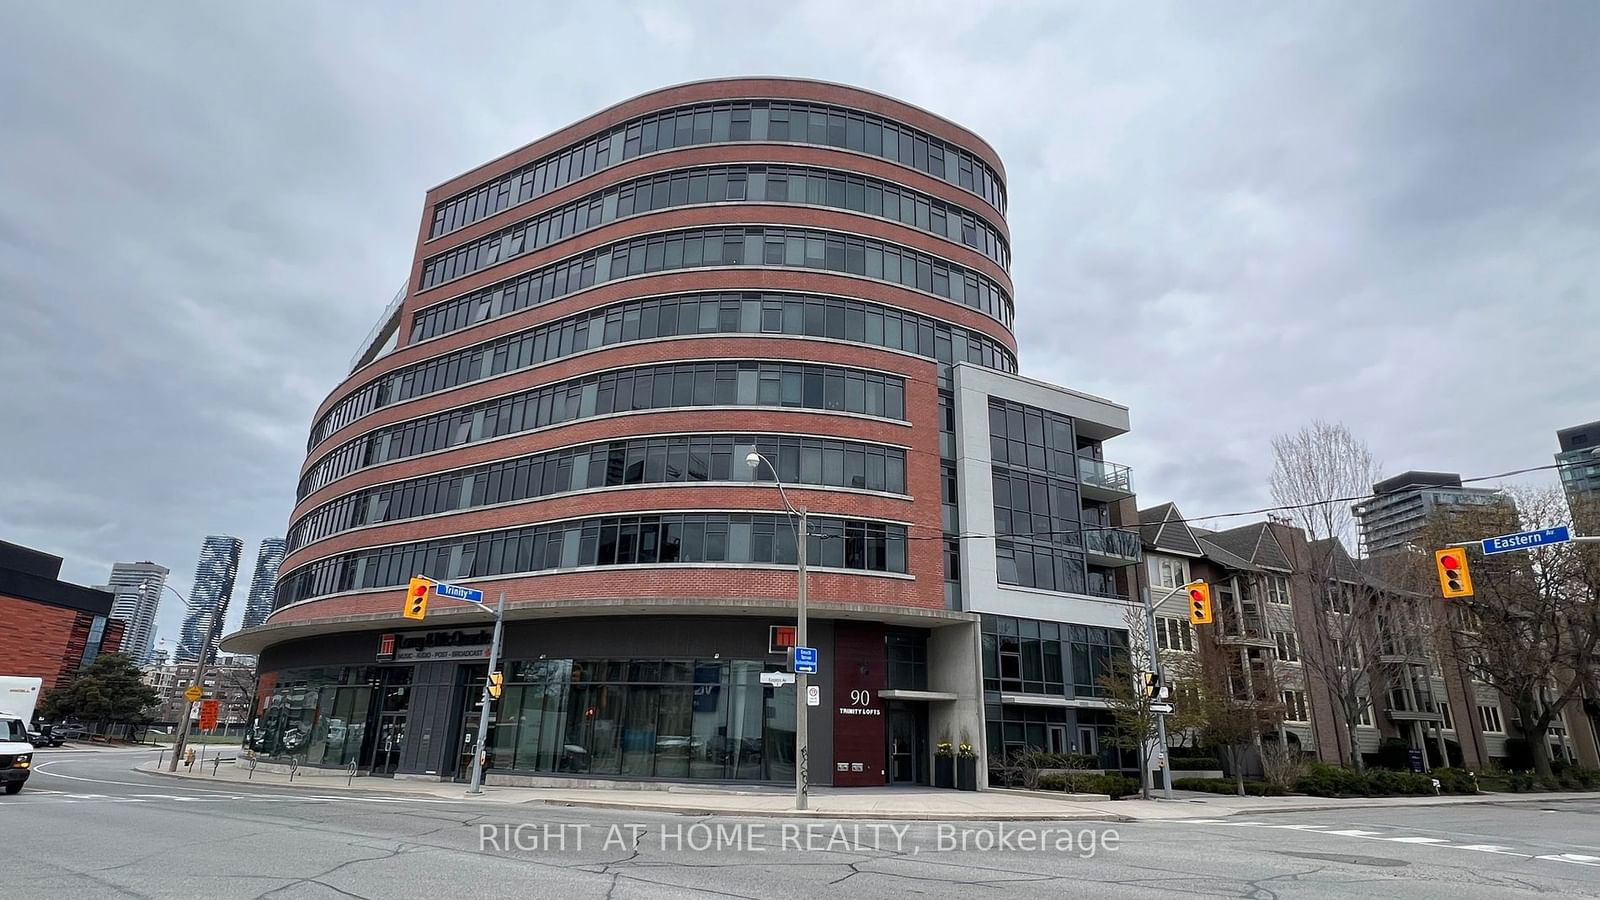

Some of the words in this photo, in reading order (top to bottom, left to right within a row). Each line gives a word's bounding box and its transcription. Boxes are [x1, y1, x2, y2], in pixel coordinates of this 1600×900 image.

[1493, 533, 1542, 549] Eastern
[445, 586, 469, 599] Trinity
[452, 649, 482, 657] BROADCAST
[850, 689, 870, 706] 90
[839, 707, 862, 715] TRINITY
[862, 708, 881, 716] LOFTS
